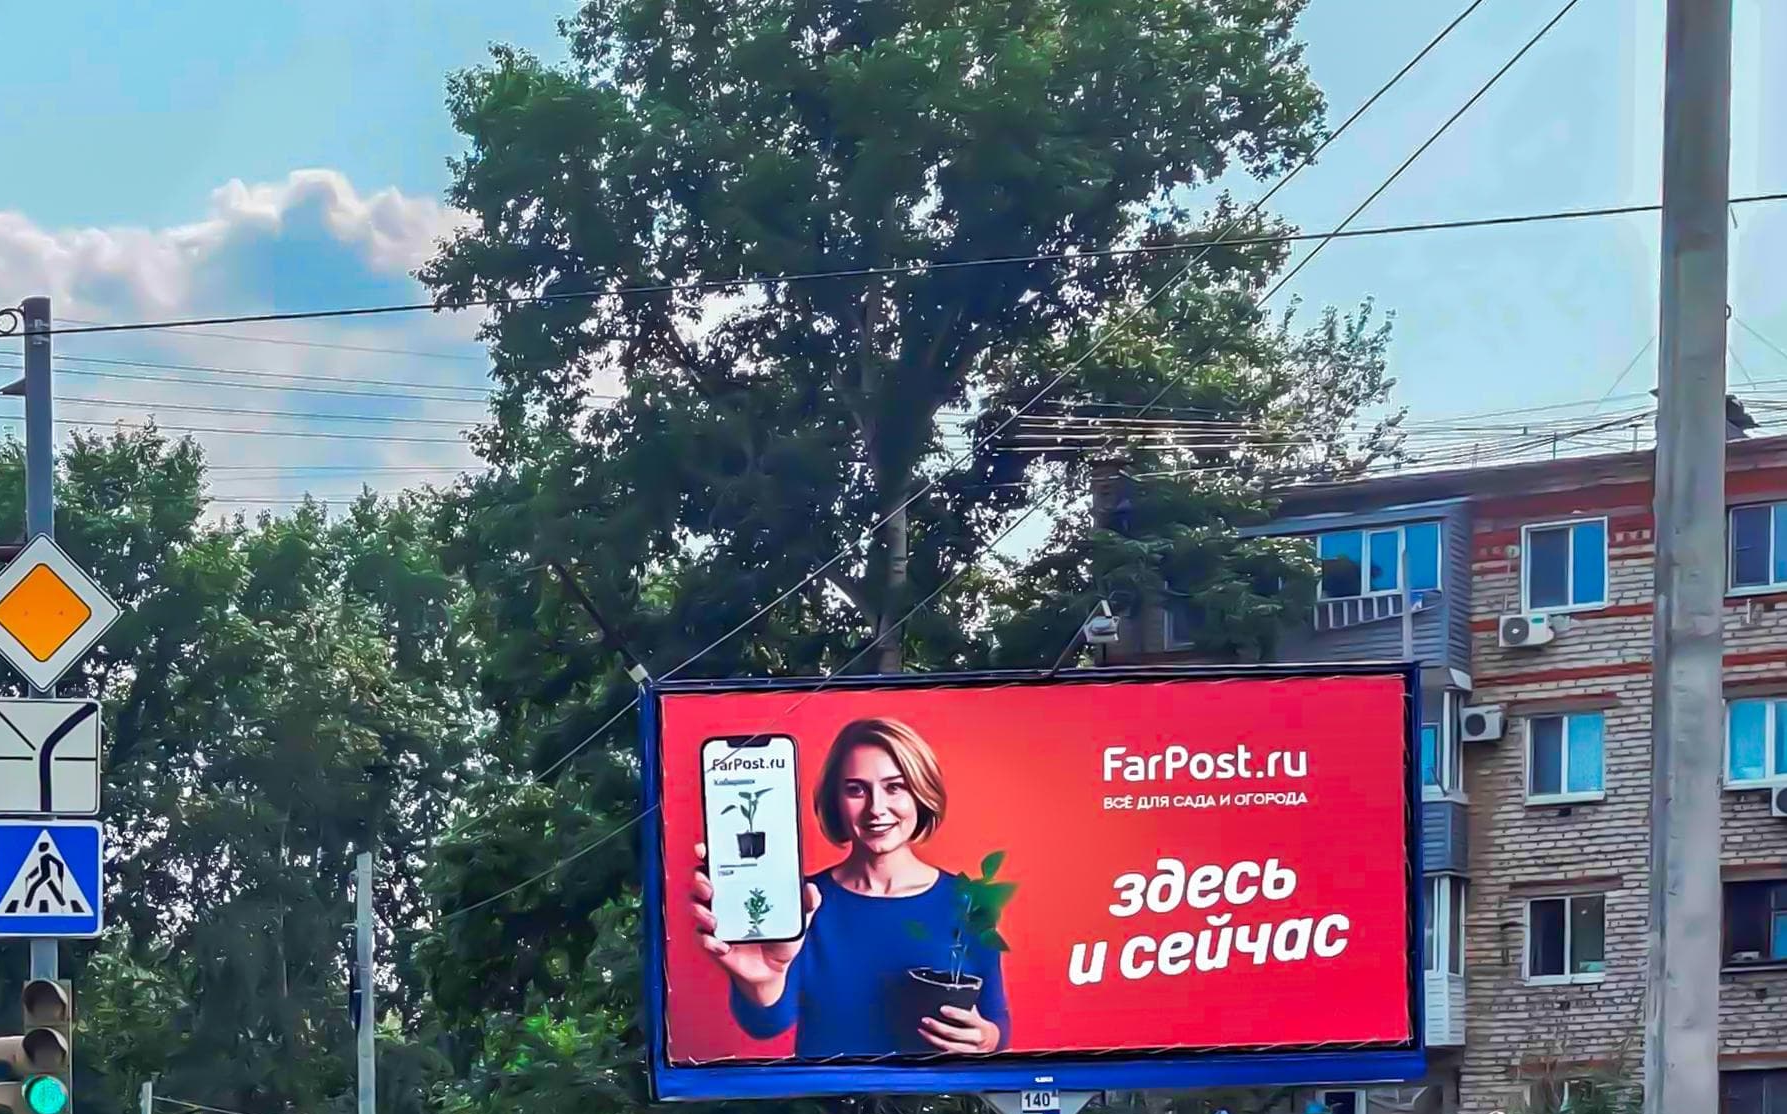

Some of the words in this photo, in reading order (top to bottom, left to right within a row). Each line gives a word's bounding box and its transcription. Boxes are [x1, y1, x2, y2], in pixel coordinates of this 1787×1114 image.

[712, 757, 785, 771] FarPost.ru
[1103, 744, 1308, 782] FarPost.ru
[1103, 794, 1134, 810] ВСЁ
[1137, 794, 1170, 810] ДЛЯ
[1173, 793, 1217, 808] САДА
[1219, 793, 1231, 806] И
[1234, 791, 1308, 806] ОГОРОДА
[1108, 857, 1297, 918] здесь
[1068, 940, 1108, 986] и
[1119, 913, 1351, 980] сейчас
[1024, 1092, 1051, 1108] 140
